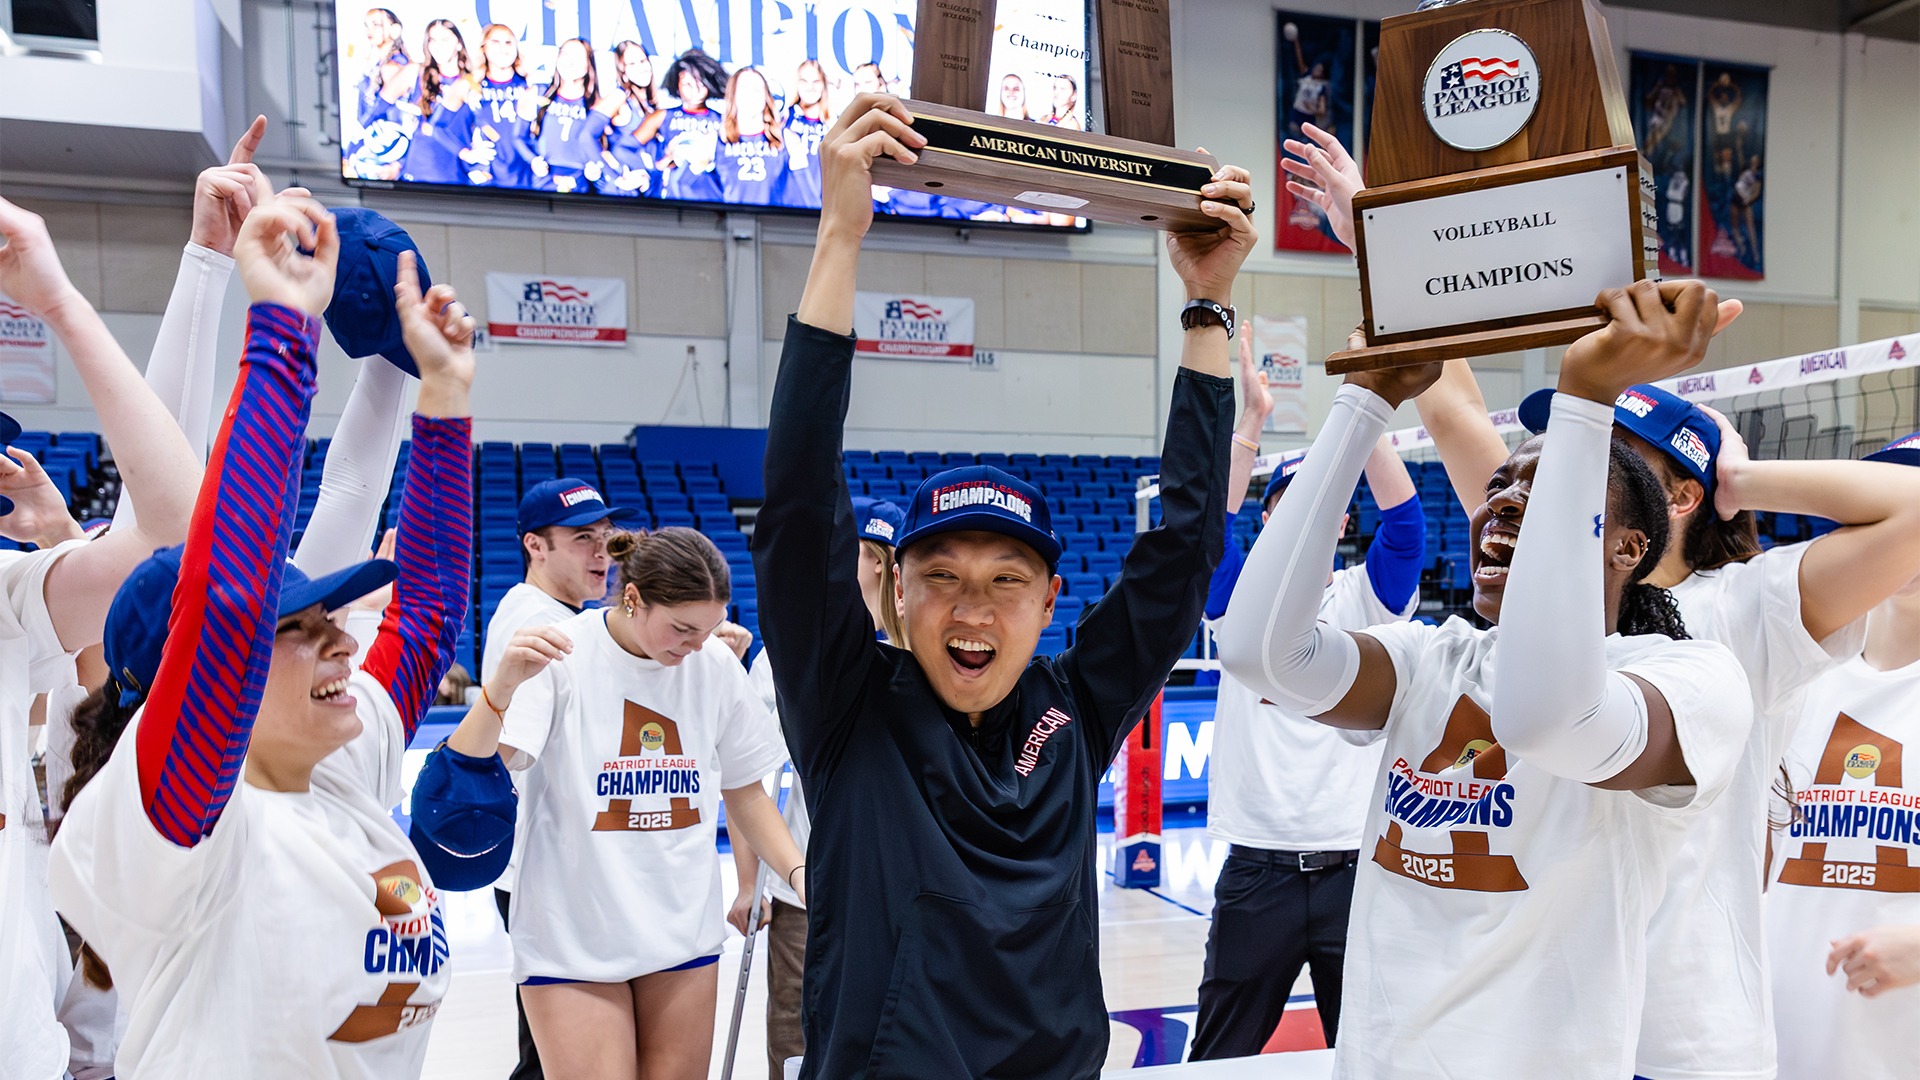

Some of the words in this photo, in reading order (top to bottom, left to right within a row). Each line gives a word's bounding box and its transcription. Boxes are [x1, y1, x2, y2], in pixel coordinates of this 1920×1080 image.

[1433, 76, 1529, 106] PATRIOT
[1434, 89, 1531, 118] LEAGUE
[558, 116, 573, 142] 7
[737, 157, 767, 182] 23
[970, 135, 1057, 162] AMERICAN
[1060, 150, 1153, 177] UNIVERSITY
[1433, 210, 1557, 242] VOLLEYBALL
[1425, 257, 1574, 296] CHAMPIONS
[1800, 350, 1847, 376] AMERICAN
[1677, 374, 1716, 394] AMERICAN
[942, 480, 990, 494] PATRIOT
[992, 482, 1032, 504] LEAGUE
[1014, 706, 1072, 777] AMERICAN
[603, 759, 652, 771] PATRIOT
[655, 758, 697, 769] LEAGUE
[1392, 757, 1453, 797] PATRIOT
[596, 769, 700, 797] CHAMPIONS
[1797, 790, 1856, 803] PATRIOT
[628, 813, 672, 829] 2025
[1401, 854, 1455, 882] 2025
[1822, 864, 1877, 886] 2025
